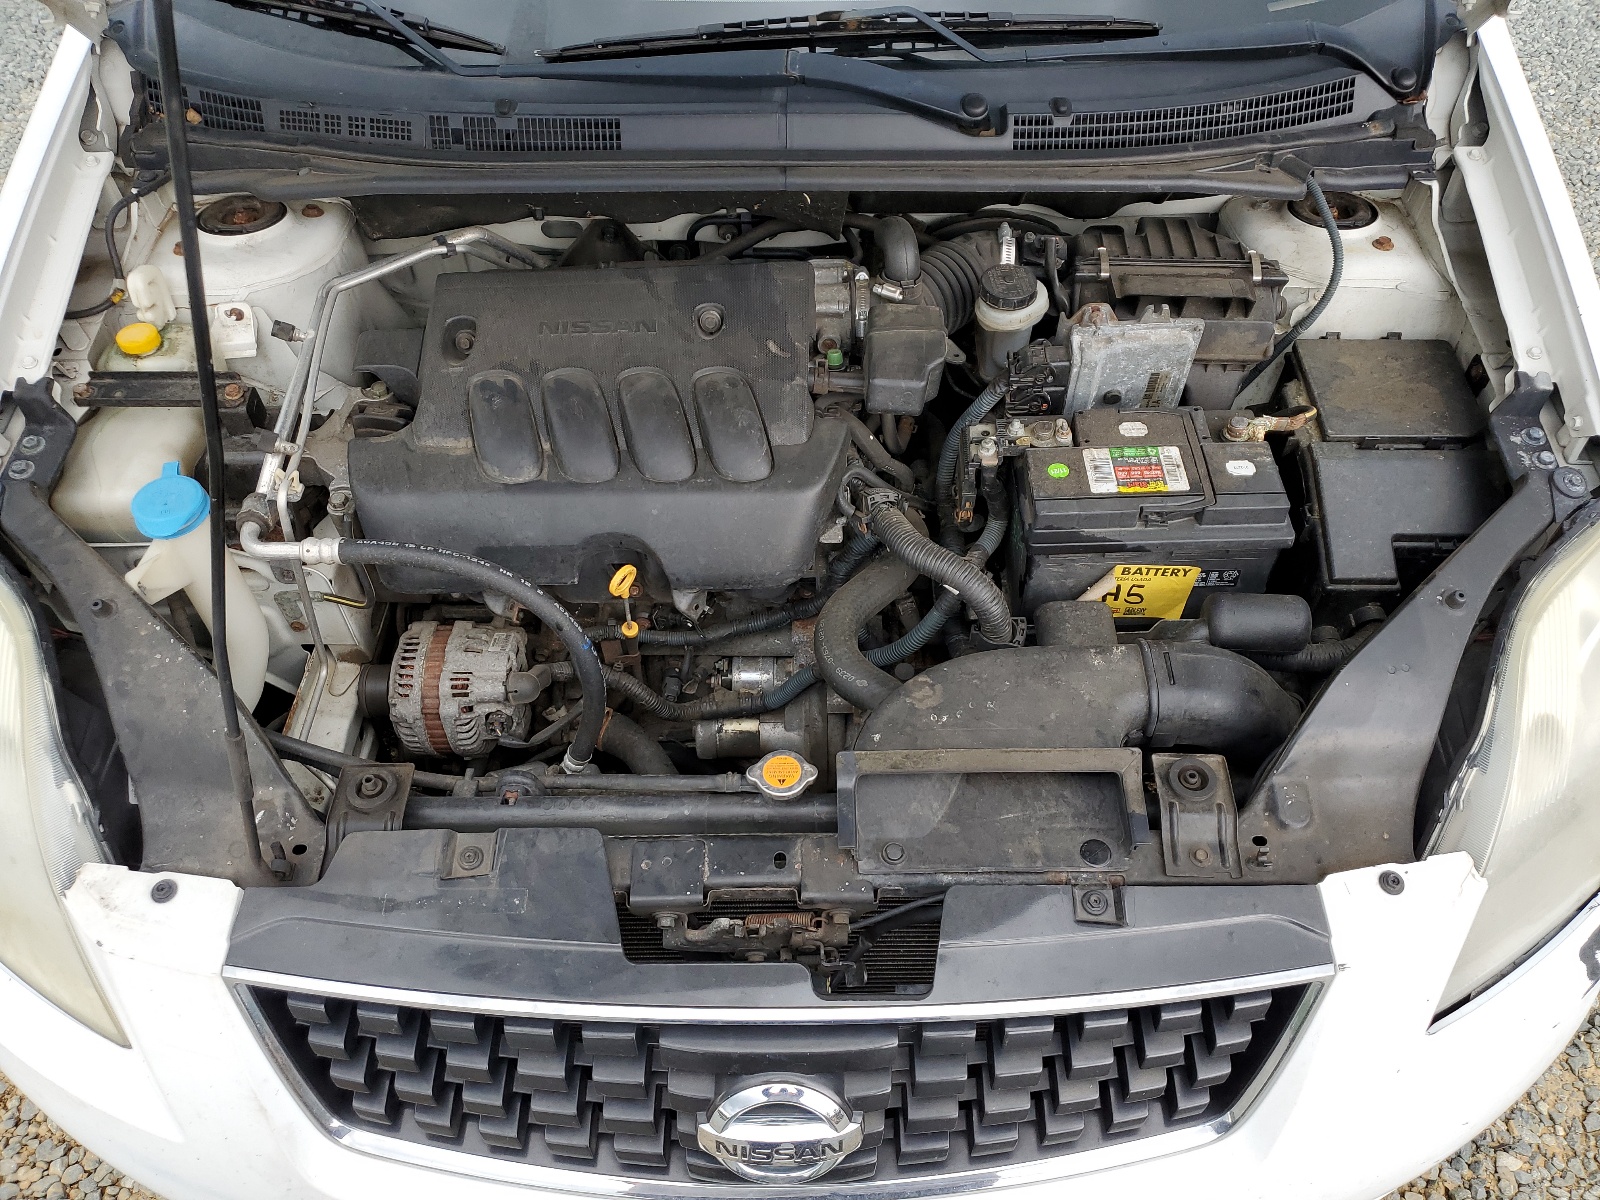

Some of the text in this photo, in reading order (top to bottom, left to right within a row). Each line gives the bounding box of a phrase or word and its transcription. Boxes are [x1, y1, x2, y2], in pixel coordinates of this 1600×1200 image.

[539, 320, 659, 336] NISSAN
[1120, 567, 1193, 577] BATTERY
[715, 1139, 845, 1165] NISSAN
